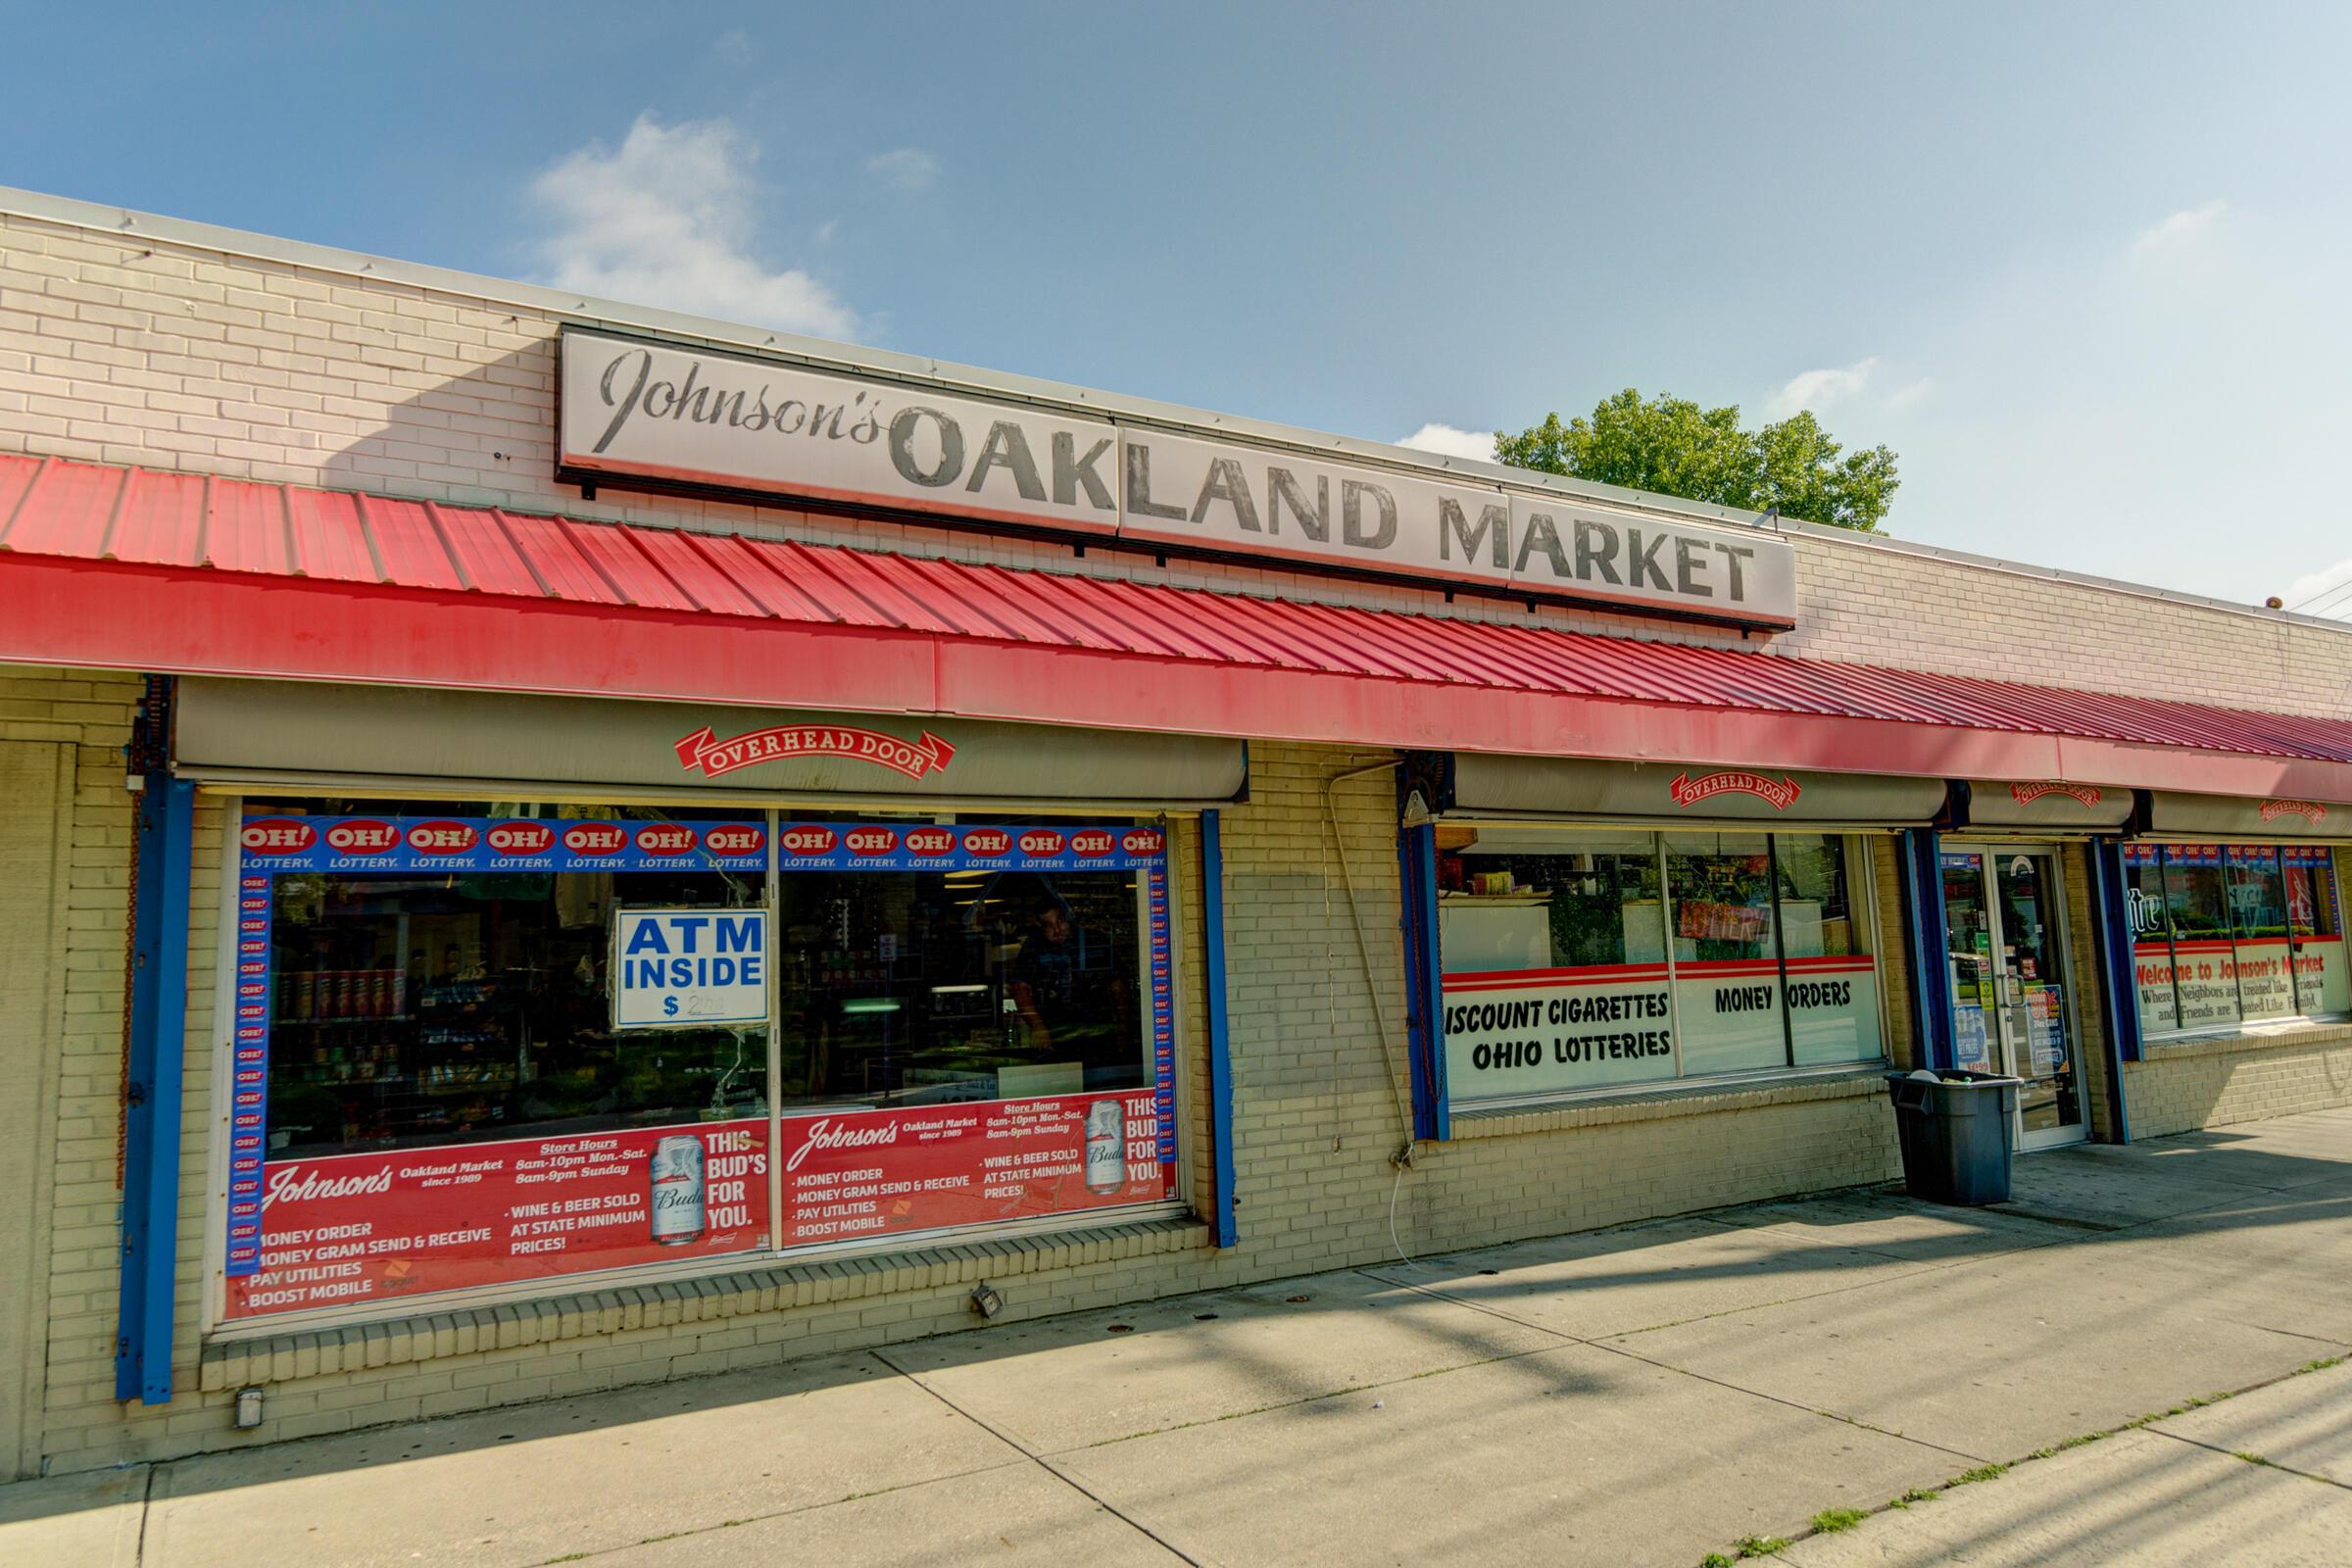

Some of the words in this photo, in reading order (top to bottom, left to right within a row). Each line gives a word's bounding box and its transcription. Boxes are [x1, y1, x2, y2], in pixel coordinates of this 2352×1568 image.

[592, 348, 887, 454] Johnson's
[889, 405, 1397, 551] OAKLAND
[1439, 495, 1754, 602] MARKET
[709, 731, 855, 769] OVERHEAD
[861, 736, 925, 773] DOOR
[1685, 775, 1753, 802] OVERHEAD
[1755, 779, 1787, 806] DOOR
[241, 826, 311, 848] OH!
[328, 826, 395, 848] OH!
[409, 826, 472, 848] OH!
[489, 828, 549, 848] OH!
[564, 828, 622, 848] OH!
[637, 829, 692, 849] OH!
[707, 830, 759, 849] OH!
[625, 917, 761, 955] ATM
[625, 956, 761, 989] INSIDE
[2197, 960, 2212, 980] to
[1716, 985, 1772, 1012] MONEY
[1788, 981, 1850, 1009] ORDERS
[2141, 989, 2173, 1004] Where
[2179, 985, 2224, 1002] Neighbors
[2243, 981, 2272, 996] treated
[2296, 977, 2324, 990] riends
[1445, 1001, 1544, 1035] ISCOUNT
[1548, 993, 1668, 1024] CIGARETTES
[2158, 1005, 2176, 1020] and
[2233, 998, 2264, 1013] Teated
[1473, 1041, 1542, 1069] OHIO
[1554, 1031, 1670, 1063] LOTTERIES
[1004, 1103, 1031, 1115] Store
[1033, 1101, 1060, 1113] Hours
[1125, 1097, 1156, 1116] THIS
[986, 1113, 1038, 1127] 8am-10pm
[1040, 1110, 1083, 1122] Mon.-Sat.
[706, 1130, 751, 1153] THIS
[918, 1131, 941, 1141] since
[986, 1127, 1032, 1140] 8am-9pm
[1034, 1123, 1070, 1135] Sunday
[540, 1142, 575, 1154] Store
[579, 1138, 617, 1152] Hours
[786, 1119, 898, 1172] Johnson's
[903, 1120, 944, 1132] Oakland
[946, 1117, 977, 1128] Market
[1127, 1140, 1156, 1160] FOR
[515, 1154, 586, 1171] 8am-10pm
[589, 1148, 648, 1163] Mon.-Sat.
[708, 1153, 766, 1179] BUD'S
[984, 1154, 1012, 1169] WINE
[1013, 1153, 1021, 1165] &
[1023, 1151, 1050, 1164] BEER
[1051, 1148, 1078, 1161] SOLD
[421, 1176, 451, 1188] since
[515, 1169, 578, 1185] 8am-9pm
[580, 1163, 630, 1178] Sunday
[797, 1172, 841, 1187] MONEY
[842, 1168, 883, 1182] ORDER
[984, 1171, 998, 1185] AT
[999, 1167, 1031, 1183] STATE
[1032, 1162, 1082, 1179] MINIMUM
[1128, 1161, 1162, 1182] YOU.
[261, 1164, 394, 1212] Johnson's
[400, 1163, 456, 1179] Oakland
[460, 1160, 503, 1173] Market
[708, 1180, 745, 1204] FOR
[797, 1189, 841, 1203] MONEY
[843, 1184, 878, 1199] GRAM
[880, 1181, 911, 1195] SEND
[913, 1180, 922, 1192] &
[924, 1175, 970, 1190] RECEIVE
[984, 1184, 1024, 1200] PRICES!
[512, 1201, 549, 1219] WINE
[552, 1200, 561, 1214] &
[564, 1197, 601, 1214] BEER
[604, 1193, 641, 1208] SOLD
[708, 1204, 753, 1229] YOU.
[797, 1208, 820, 1220] PAY
[822, 1200, 877, 1217] UTILITIES
[316, 1222, 372, 1241] ORDER
[511, 1222, 528, 1239] AT
[531, 1217, 575, 1235] STATE
[577, 1209, 646, 1231] MINIMUM
[797, 1221, 839, 1237] BOOST
[840, 1216, 885, 1232] MOBILE
[317, 1242, 366, 1260] GRAM
[368, 1237, 411, 1254] SEND
[414, 1235, 425, 1249] &
[428, 1227, 491, 1248] RECEIVE
[511, 1237, 566, 1255] PRICES!
[249, 1272, 283, 1288] PAY
[286, 1262, 362, 1283] UTILITIES
[249, 1288, 307, 1307] BOOST
[310, 1279, 372, 1299] MOBILE
